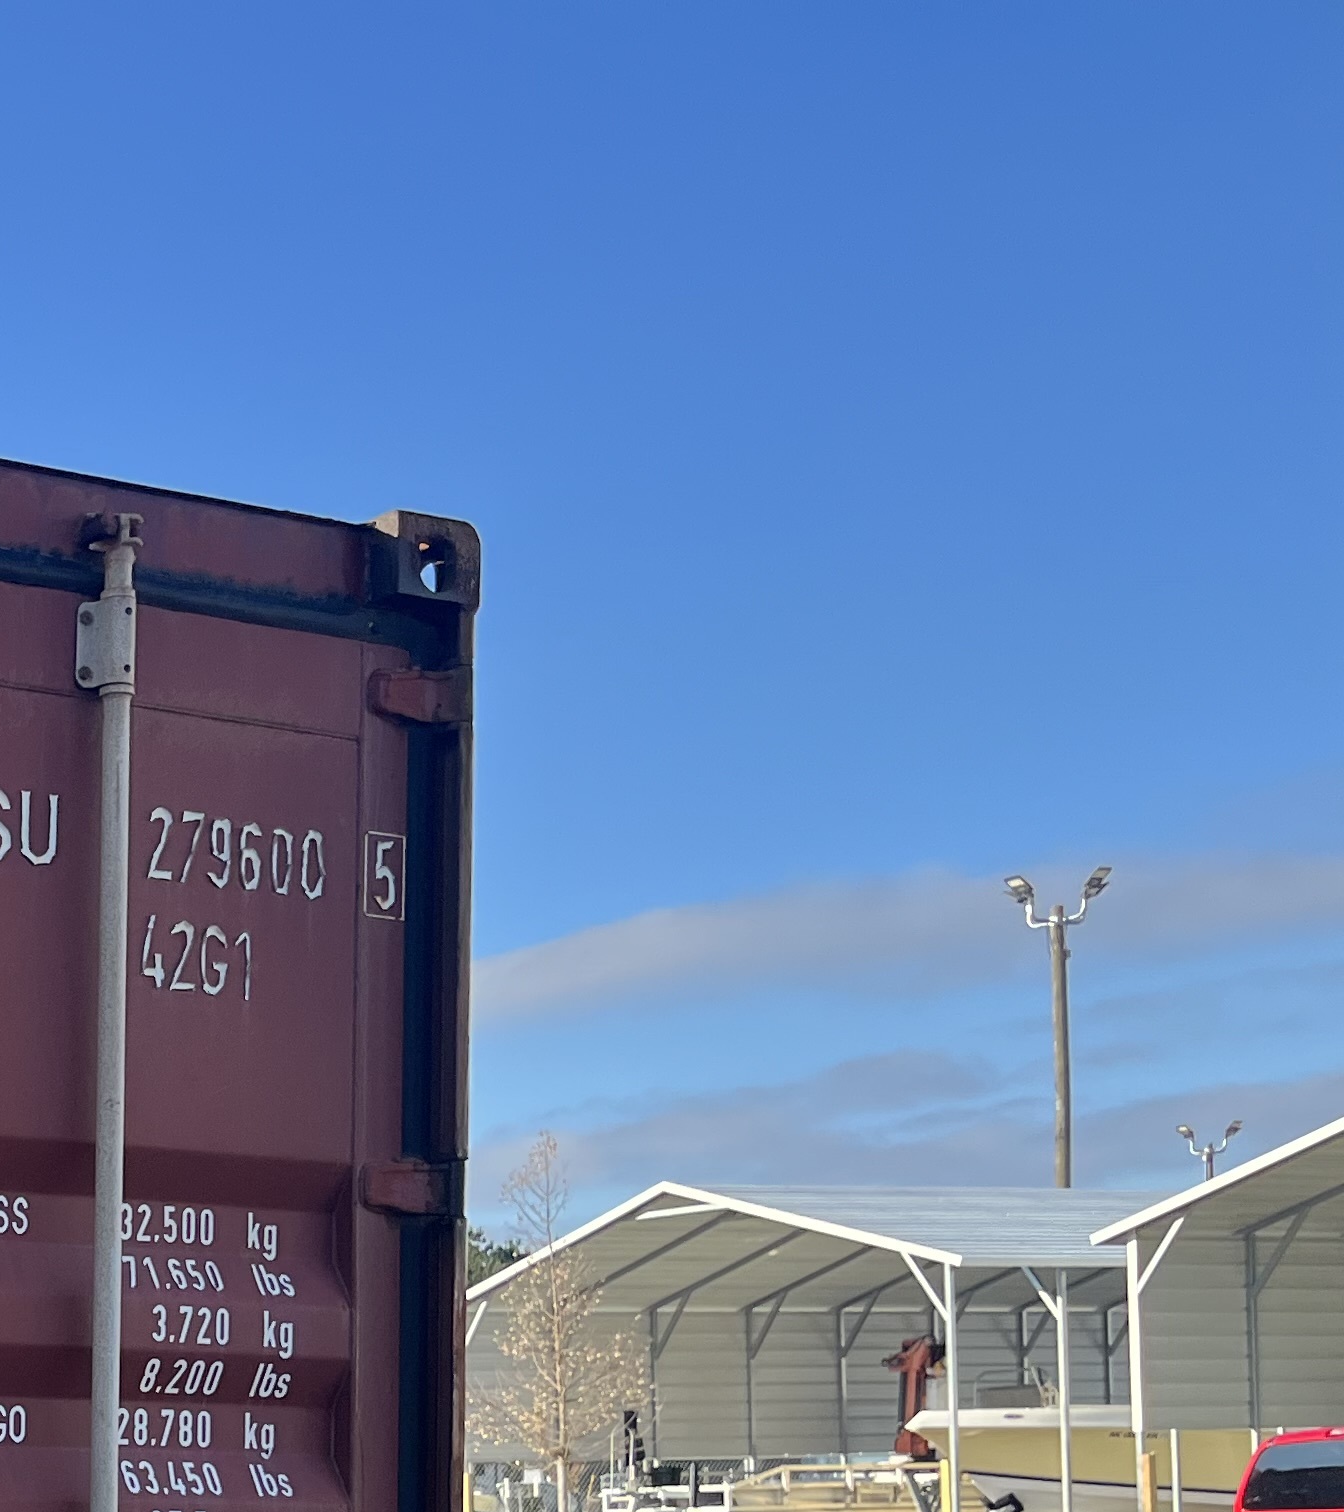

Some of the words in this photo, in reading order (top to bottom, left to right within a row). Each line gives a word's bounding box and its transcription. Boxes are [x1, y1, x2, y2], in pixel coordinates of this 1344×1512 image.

[147, 806, 326, 900] 279600
[369, 835, 400, 915] 5
[141, 914, 252, 1001] 42G1
[247, 1211, 278, 1262] kg
[250, 1263, 296, 1297] lbs
[262, 1310, 294, 1360] kg
[248, 1362, 292, 1399] lbs
[244, 1411, 275, 1460] kg
[248, 1463, 293, 1498] lbs
